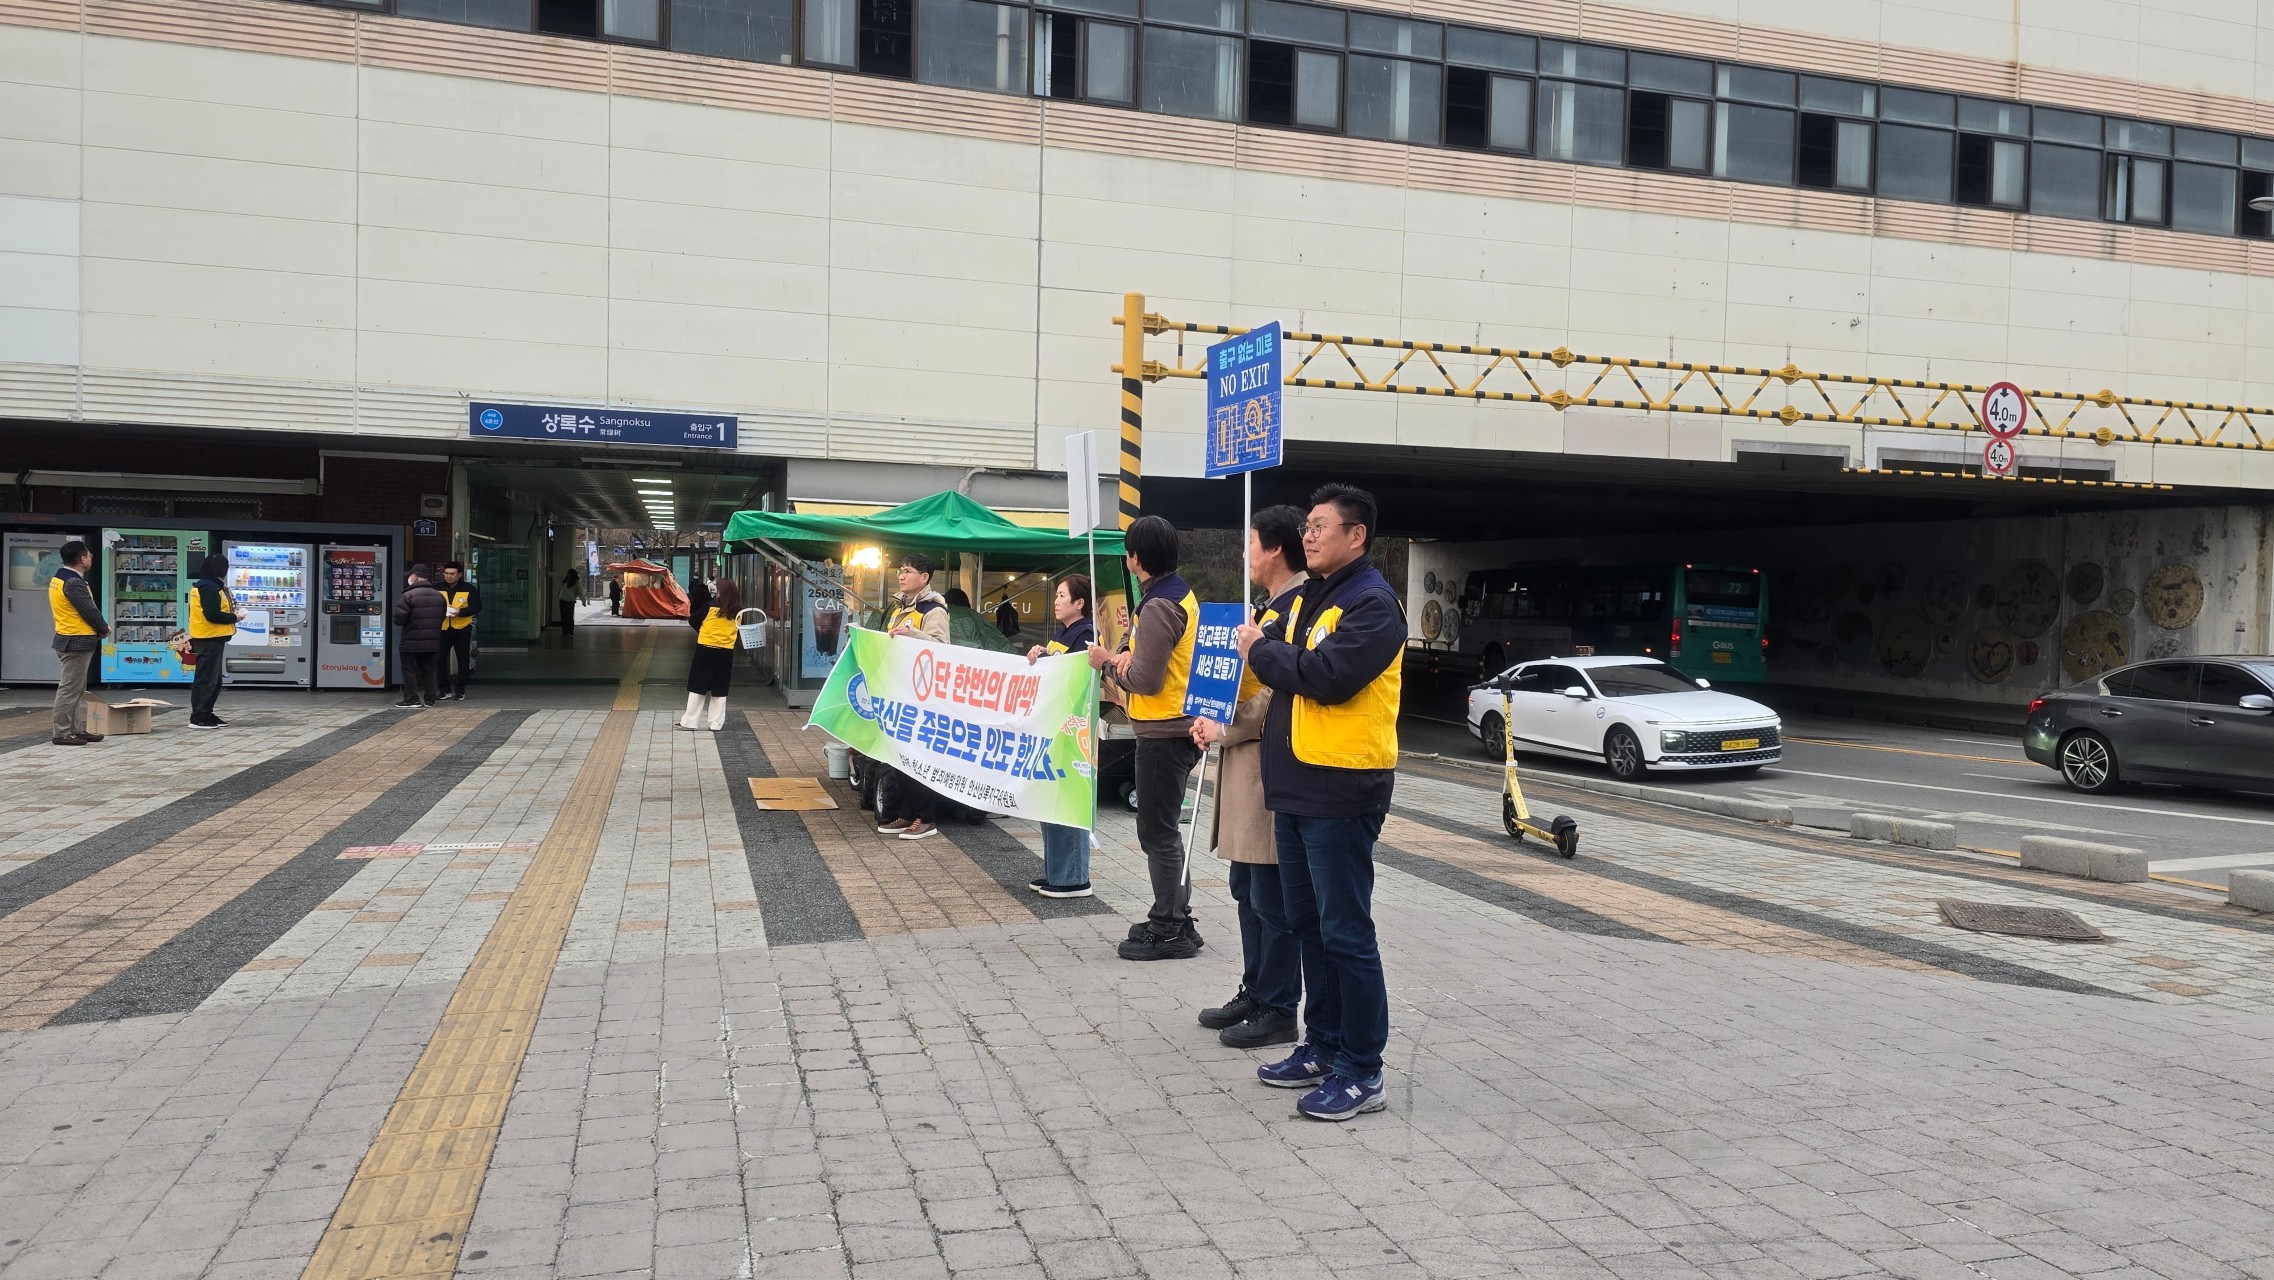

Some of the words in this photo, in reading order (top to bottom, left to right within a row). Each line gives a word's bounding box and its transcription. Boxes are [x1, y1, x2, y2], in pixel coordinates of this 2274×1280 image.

[1219, 346, 1236, 371] 출구
[1238, 341, 1254, 365] 없는
[1256, 332, 1273, 357] 미로
[1219, 373, 1237, 398] NO
[1240, 362, 1270, 393] EXIT
[1989, 398, 2017, 422] 4.0m
[541, 413, 596, 434] 상록수
[599, 416, 651, 428] Sangnoksu
[689, 422, 713, 432] 출입구
[716, 422, 725, 441] 1
[683, 432, 713, 440] Entrance
[1990, 448, 2008, 463] 4.0m
[420, 526, 430, 534] 61
[1728, 582, 1742, 594] 72
[1197, 624, 1230, 650] 학교폭력
[1712, 640, 1735, 650] GBUS
[321, 664, 359, 672] StoryWay
[1195, 654, 1214, 678] 세상
[1212, 656, 1238, 682] 만들기
[934, 660, 952, 700] 단
[952, 663, 1008, 712] 한번의
[870, 695, 919, 744] 당신을
[917, 709, 982, 763] 죽음으로
[980, 726, 1016, 773] 인도
[1010, 732, 1067, 781] 합니다.
[912, 758, 932, 780] 청소년
[930, 766, 968, 794] 범죄예방위원
